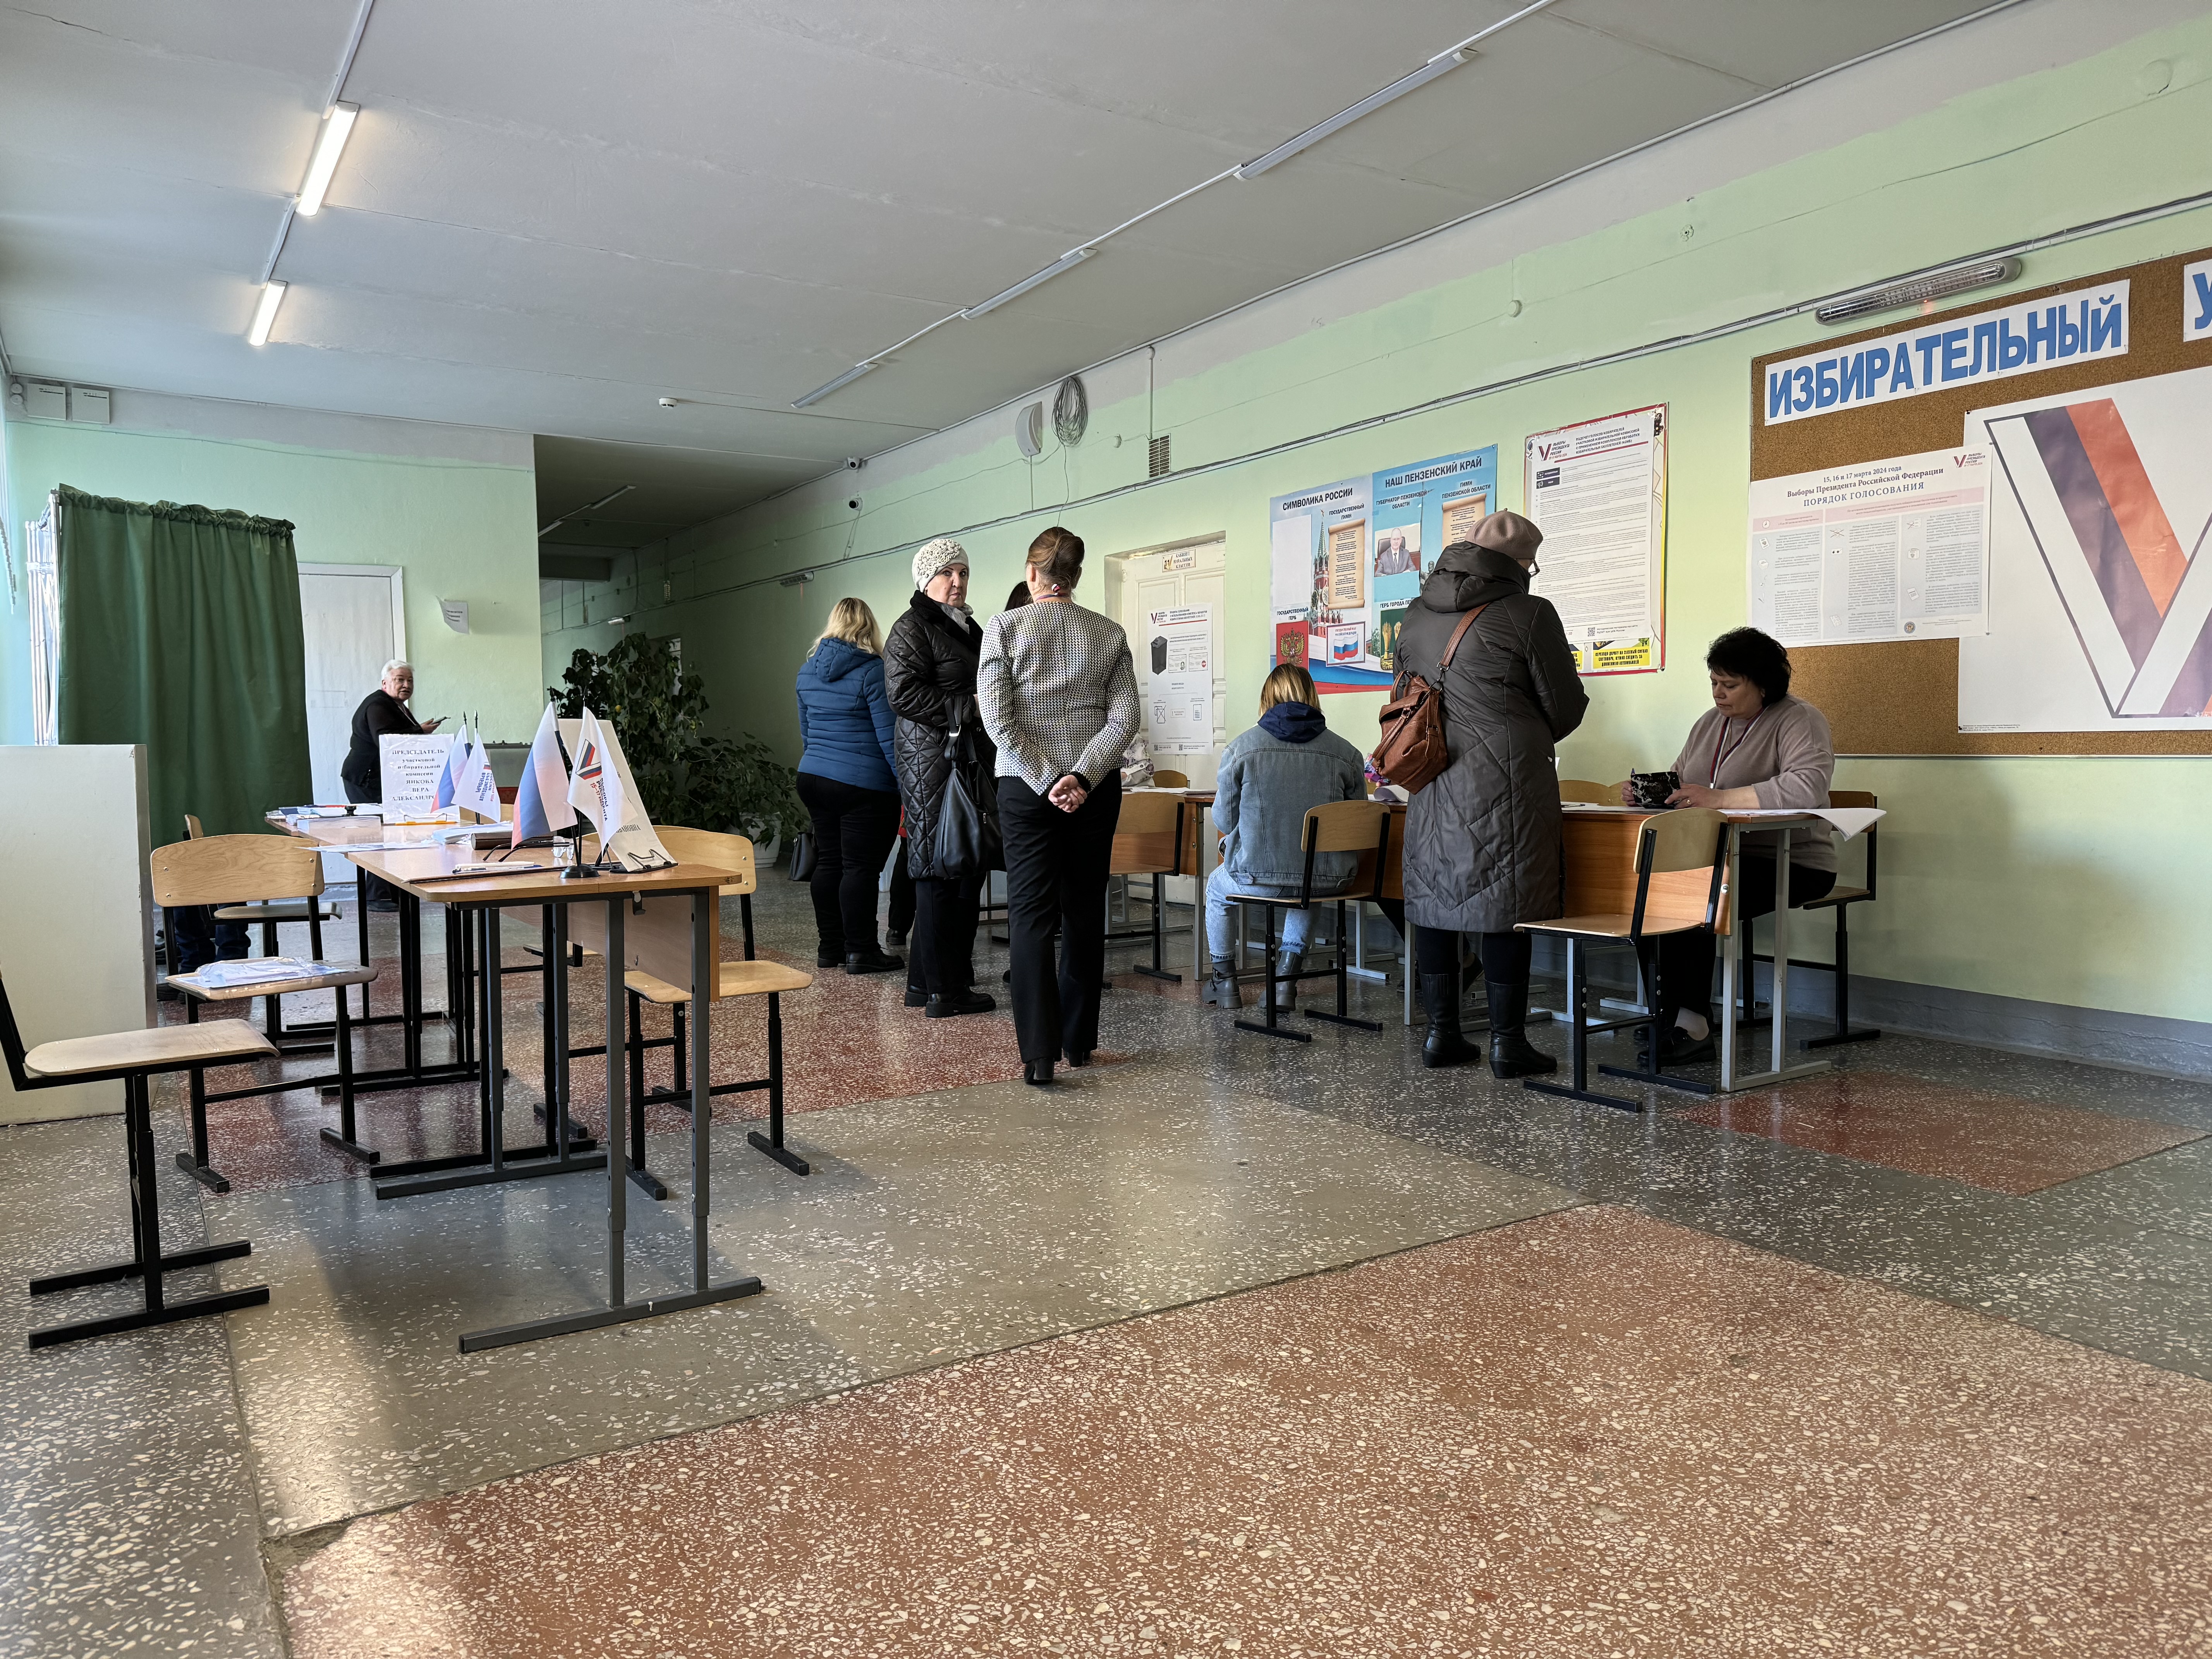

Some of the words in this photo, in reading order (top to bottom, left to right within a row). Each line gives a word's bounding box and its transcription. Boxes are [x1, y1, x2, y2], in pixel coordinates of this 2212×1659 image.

[1770, 294, 2122, 418] ИЗБИРАТЕЛЬНЫЙ
[1385, 476, 1403, 488] НАШ
[1405, 461, 1457, 483] ПЕНЗЕНСКИЙ
[1460, 456, 1482, 471] КРАЙ
[1788, 488, 1814, 497] Выборы
[1816, 482, 1856, 494] Президента
[1858, 474, 1900, 486] Российской
[1901, 468, 1943, 479] Федерации
[1283, 495, 1323, 510] СИМВОЛИКА
[1325, 488, 1353, 501] РОССИИ
[1376, 496, 1400, 505] ГУБЕРНАТОР
[1400, 489, 1427, 500] ПЕНЗЕНСКОЙ
[1442, 488, 1470, 499] ПЕНЗЕНСКОЙ
[1471, 484, 1491, 493] ОБЛАСТИ
[1803, 494, 1847, 507] ПОРЯДОК
[1850, 482, 1924, 499] ГОЛОСОВАНИЯ
[1329, 503, 1364, 515] ГОСУДАРСТВЕННЫЙ
[1277, 606, 1309, 616] ГОСУДАРСТВЕННЫЙ
